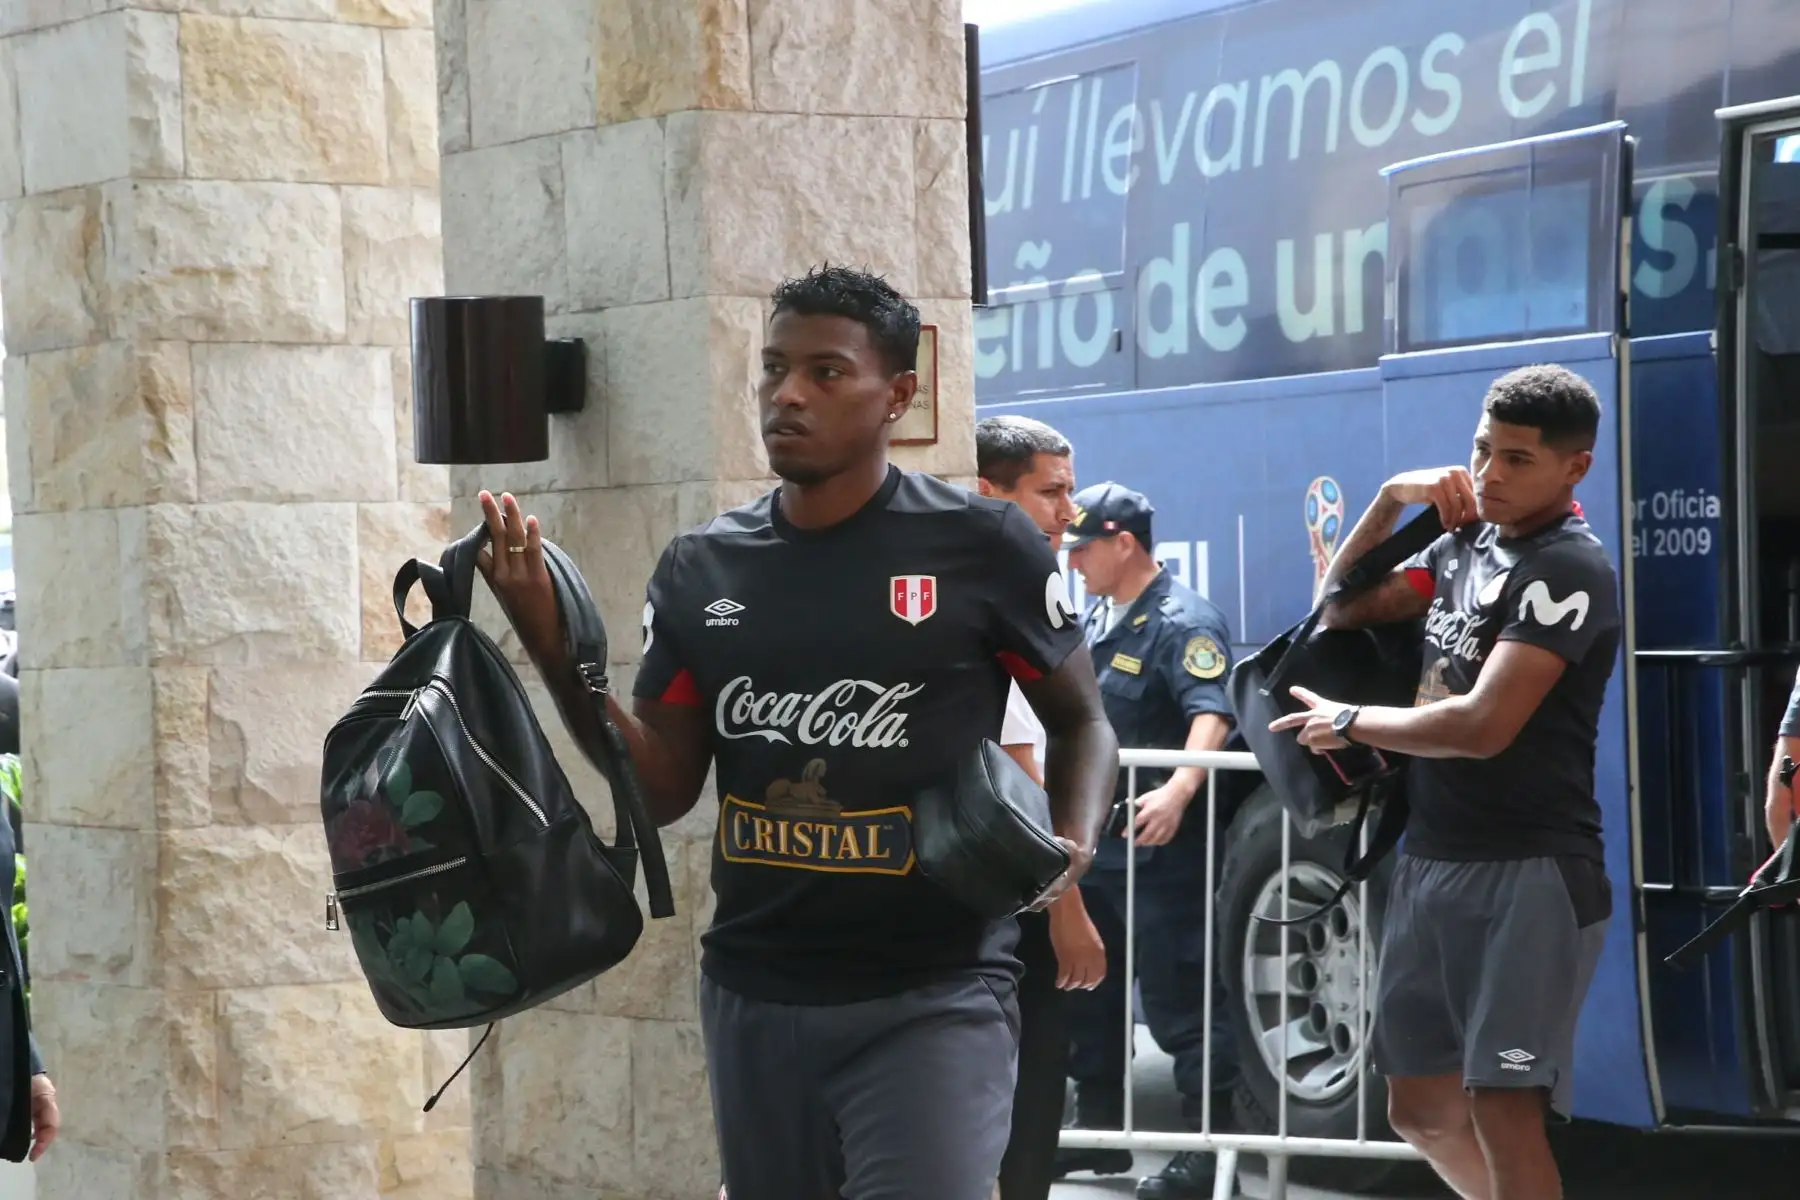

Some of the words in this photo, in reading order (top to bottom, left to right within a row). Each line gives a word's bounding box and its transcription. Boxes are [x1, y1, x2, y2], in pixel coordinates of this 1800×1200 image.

[1061, 32, 1465, 204] llevamos
[1498, 0, 1592, 118] el
[1136, 221, 1249, 360] de
[1276, 220, 1394, 343] un
[1653, 526, 1712, 556] 2009
[705, 616, 740, 627] umbro
[715, 675, 926, 748] Coca-Cola
[733, 811, 891, 861] CRISTAL
